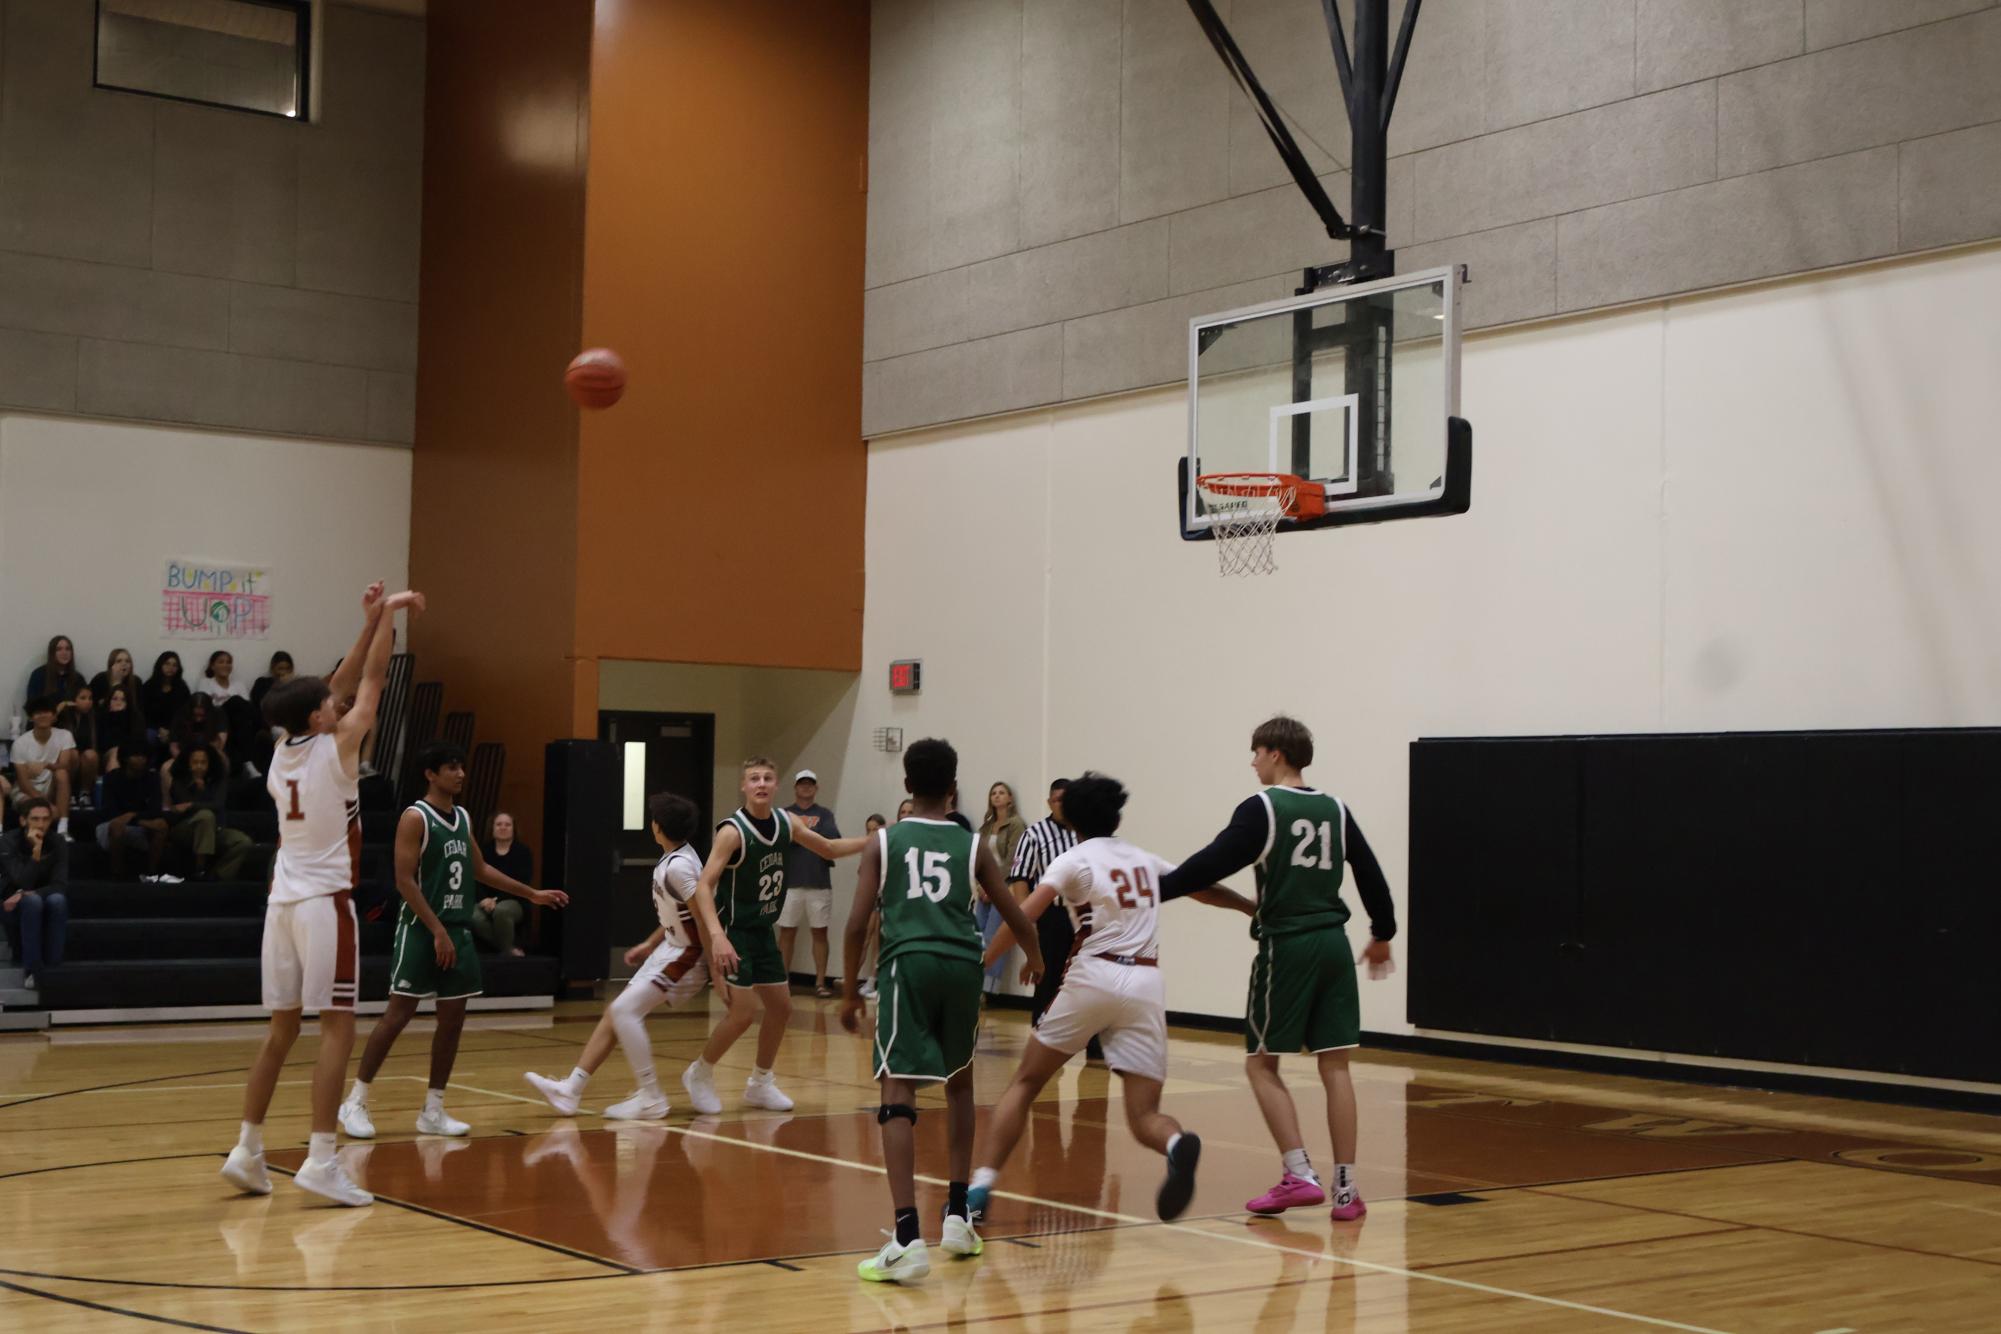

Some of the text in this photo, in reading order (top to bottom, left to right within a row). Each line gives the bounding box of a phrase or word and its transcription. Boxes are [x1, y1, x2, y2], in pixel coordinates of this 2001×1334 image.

[167, 563, 234, 593] BUMP
[286, 779, 305, 820] 1
[1290, 818, 1333, 870] 21
[448, 861, 463, 890] 3
[760, 852, 784, 873] CEDAR
[904, 846, 951, 903] 15
[758, 870, 785, 901] 23
[1109, 866, 1154, 909] 24
